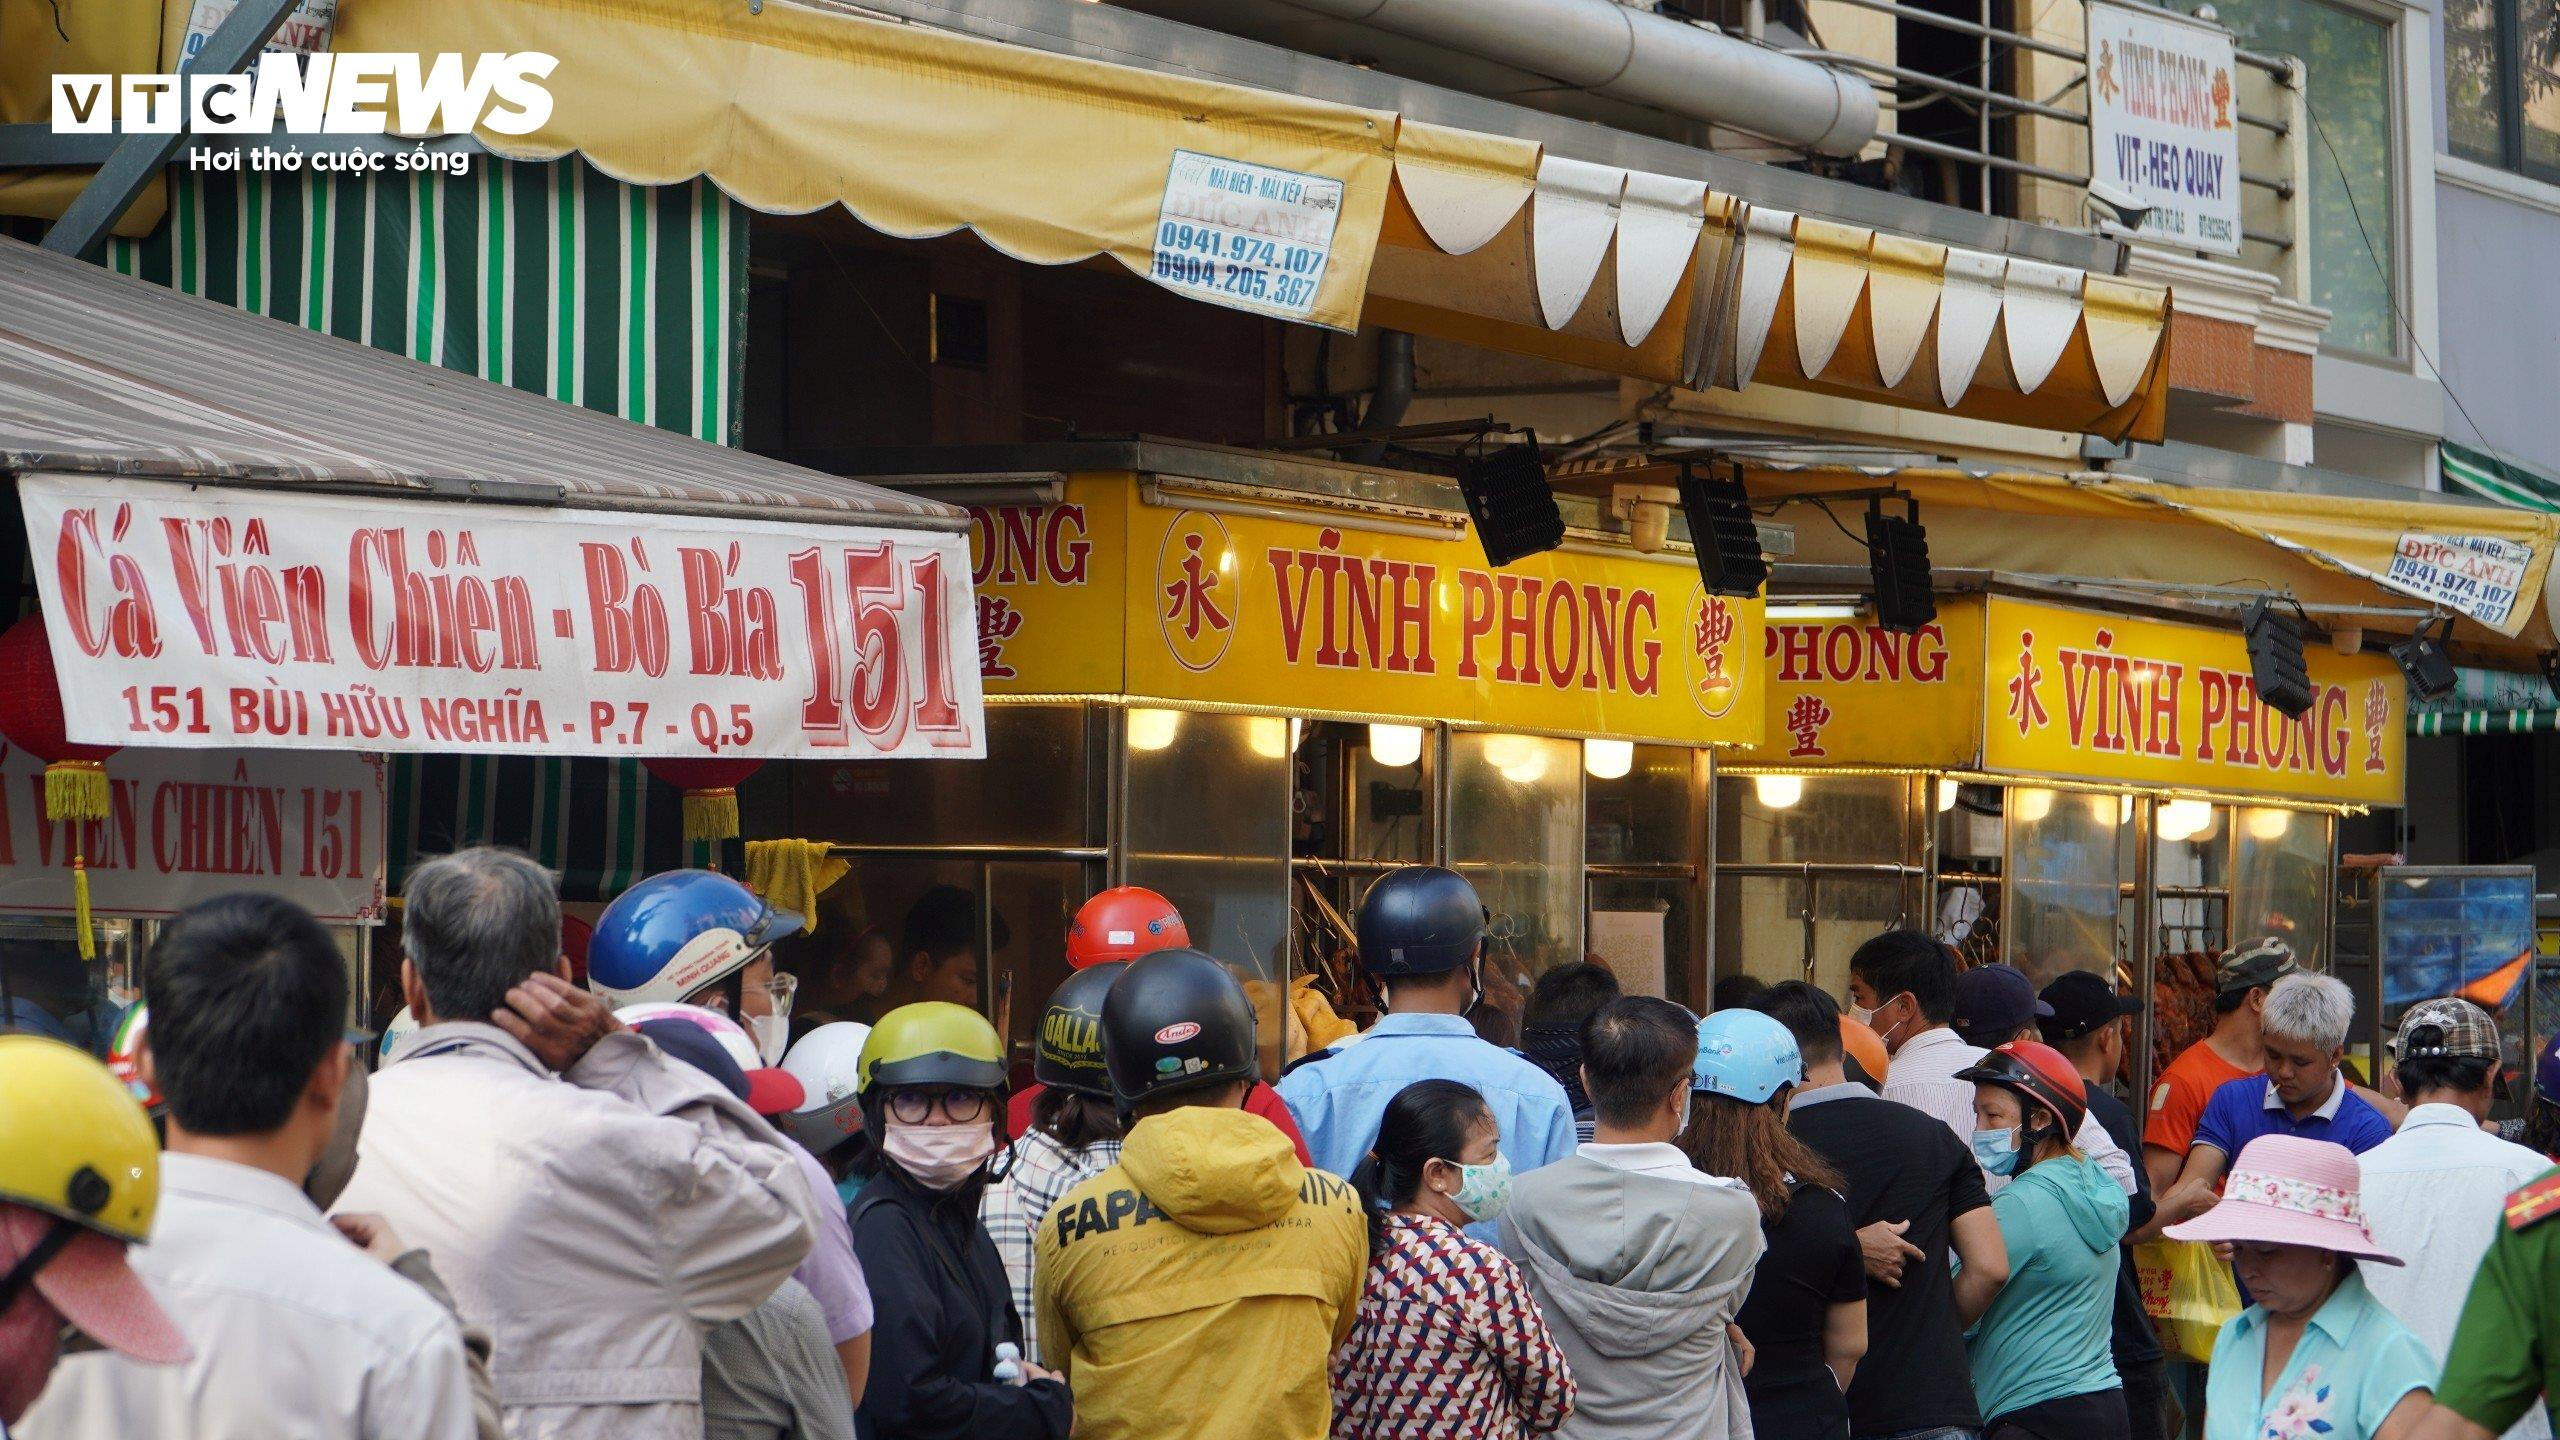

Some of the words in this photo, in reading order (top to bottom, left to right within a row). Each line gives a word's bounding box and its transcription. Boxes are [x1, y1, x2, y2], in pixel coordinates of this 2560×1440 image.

[2158, 49, 2211, 132] PHONG
[2185, 146, 2223, 200] QUAY
[1157, 251, 1316, 307] 0904.205.367
[1161, 222, 1324, 275] 0941.974.107
[56, 502, 163, 659] Cá
[160, 516, 335, 666] Viên
[348, 527, 542, 674] Chiên
[579, 536, 669, 678] Bò
[677, 540, 785, 682] Bía
[1167, 533, 1230, 640] 永
[2393, 558, 2513, 604] 0941.974.107
[2402, 539, 2456, 568] ĐỨC
[2460, 556, 2514, 587] ANH
[788, 540, 967, 748] 151
[1267, 529, 1437, 676] VĨNH
[1458, 567, 1663, 699] PHONG
[121, 686, 210, 734] 151
[230, 676, 308, 736] BÙI
[321, 684, 410, 740] HỮU
[421, 688, 549, 743] NGHĨA
[590, 701, 650, 744] P.7
[690, 703, 754, 754] Q.5
[2008, 630, 2048, 737] 永
[2058, 629, 2184, 758] VĨNH
[2198, 667, 2351, 776] PHONG
[152, 758, 285, 876] CHIÊN
[300, 787, 364, 880] 151
[700, 951, 731, 973] QUANG
[1045, 1014, 1101, 1053] DALLA
